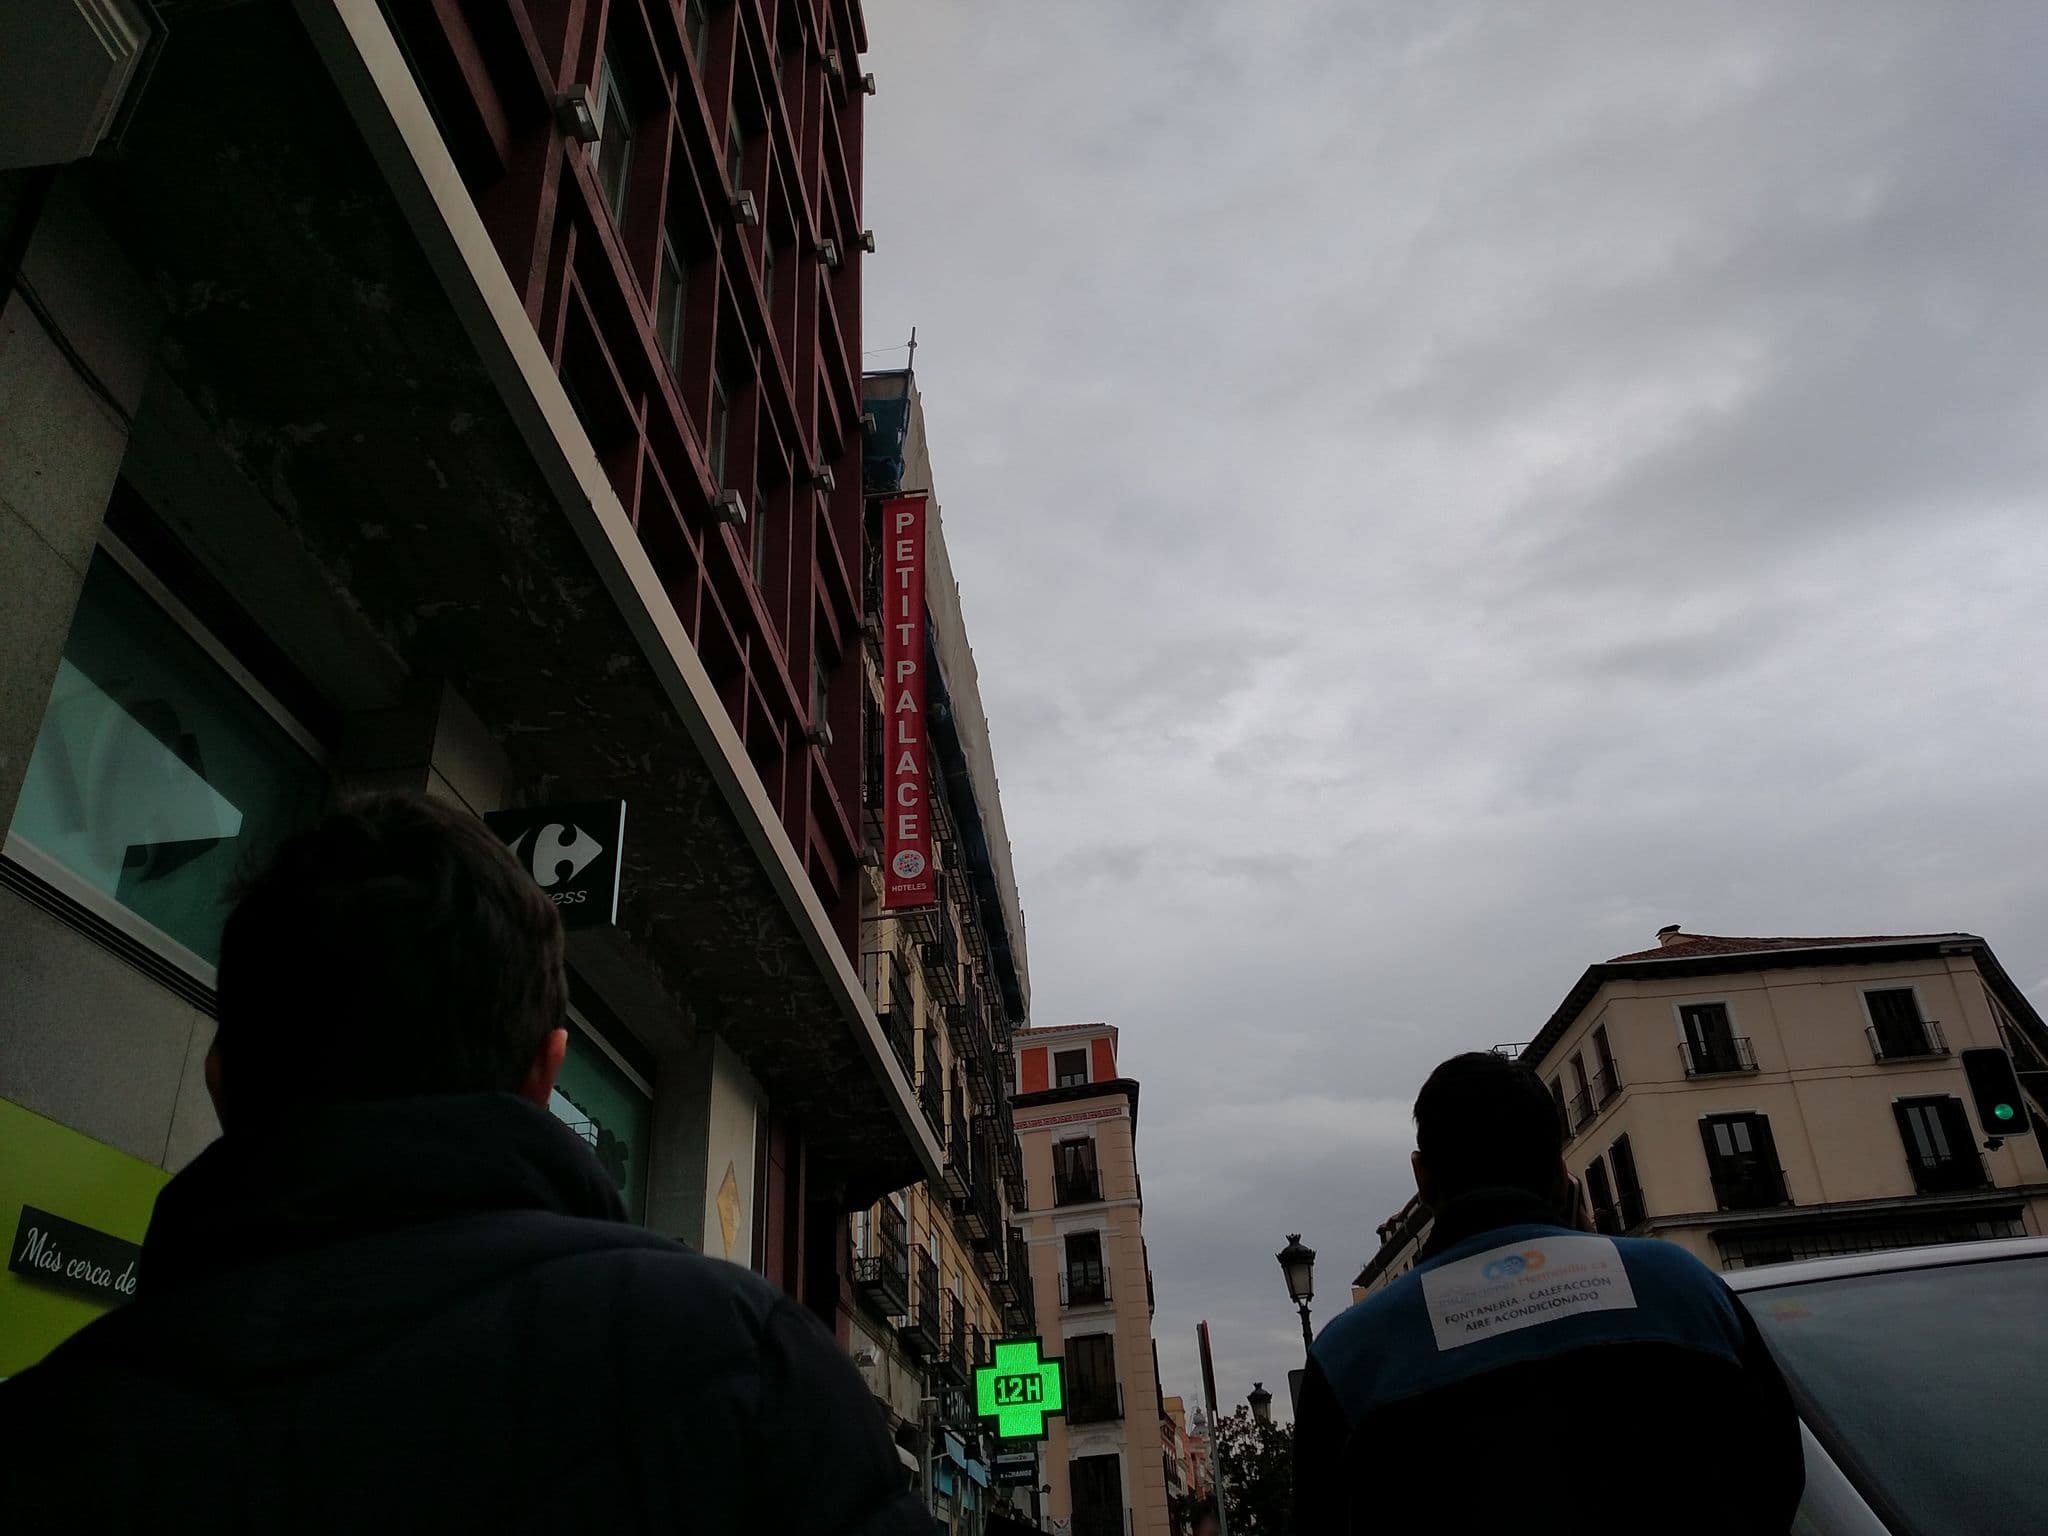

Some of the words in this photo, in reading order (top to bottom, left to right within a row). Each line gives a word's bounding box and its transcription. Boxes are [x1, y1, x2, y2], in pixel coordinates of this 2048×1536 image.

[896, 512, 915, 646] PETIT
[895, 660, 920, 840] PALACE
[550, 890, 587, 905] ess
[892, 882, 927, 892] HOTELES
[19, 1227, 63, 1272] Más
[66, 1258, 113, 1288] cerca
[115, 1261, 137, 1295] de
[1465, 1318, 1491, 1332] AIRE
[1495, 1290, 1599, 1322] ACONDICIONADO
[997, 1376, 1041, 1403] 12H
